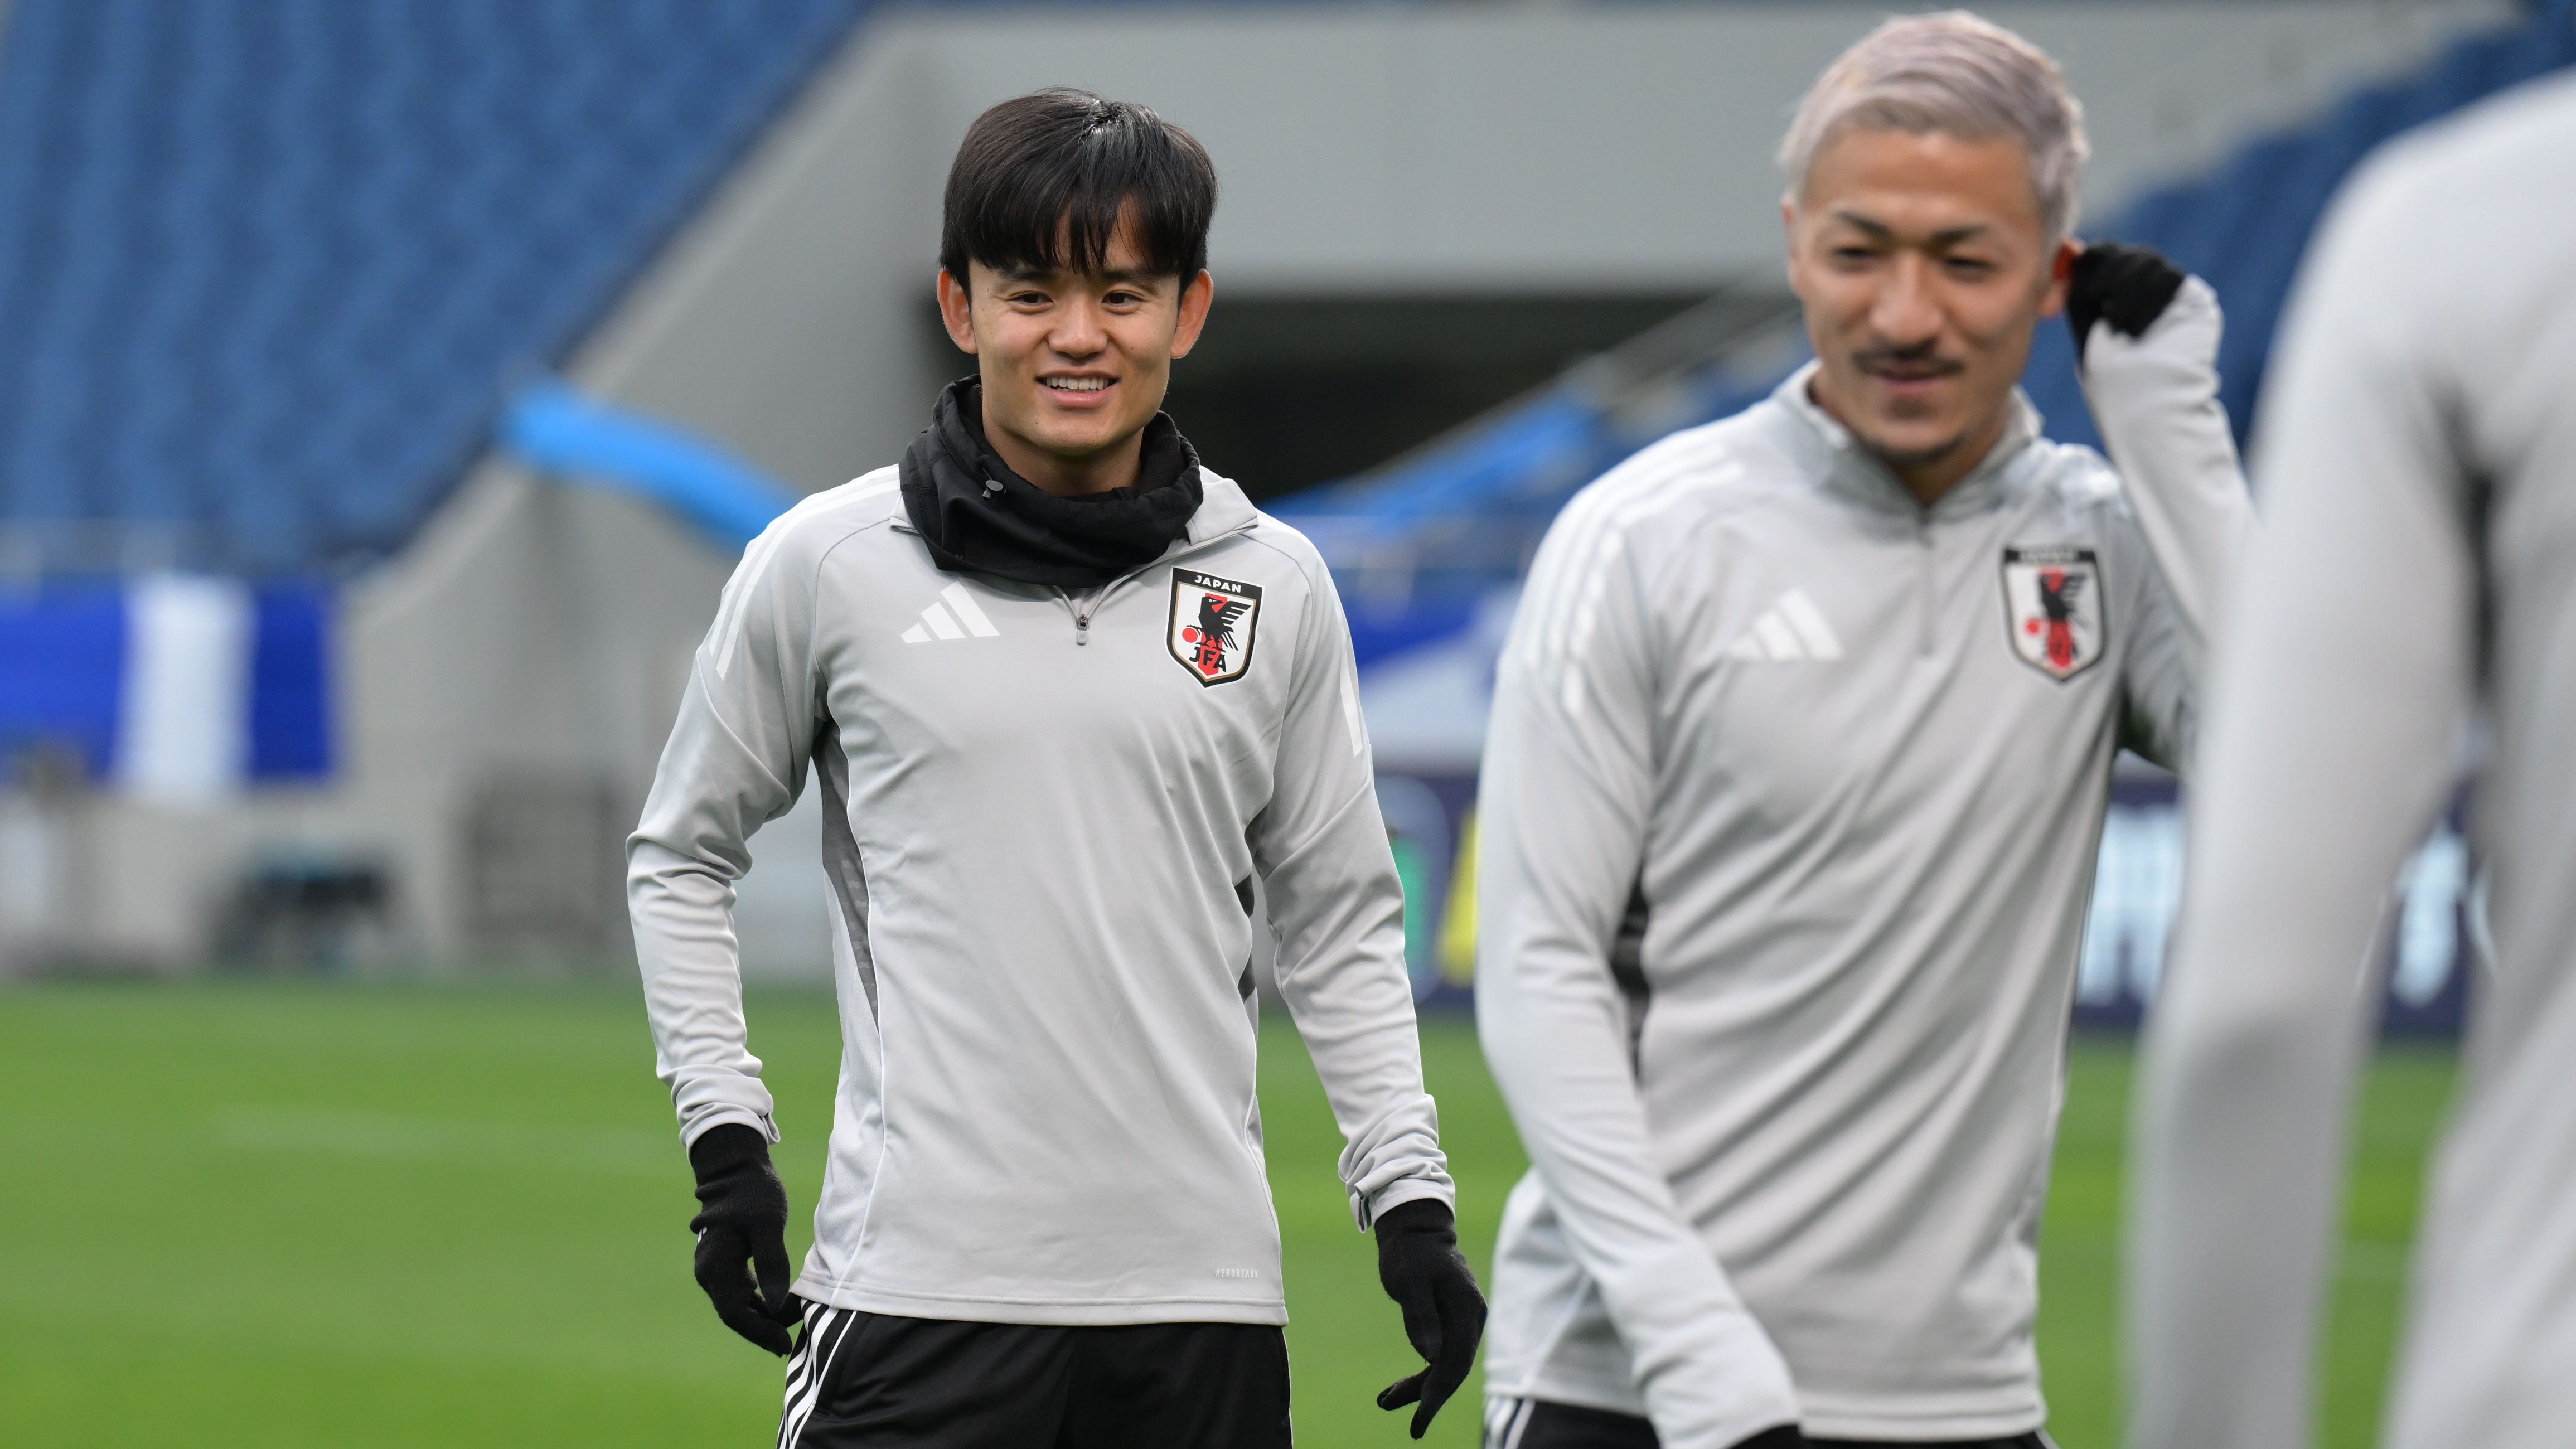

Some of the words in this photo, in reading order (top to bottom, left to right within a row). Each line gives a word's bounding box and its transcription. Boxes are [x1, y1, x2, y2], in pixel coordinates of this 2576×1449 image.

[1194, 575, 1242, 593] JAPAN
[1189, 647, 1227, 672] JFA
[1216, 1268, 1258, 1278] AEROREADY
